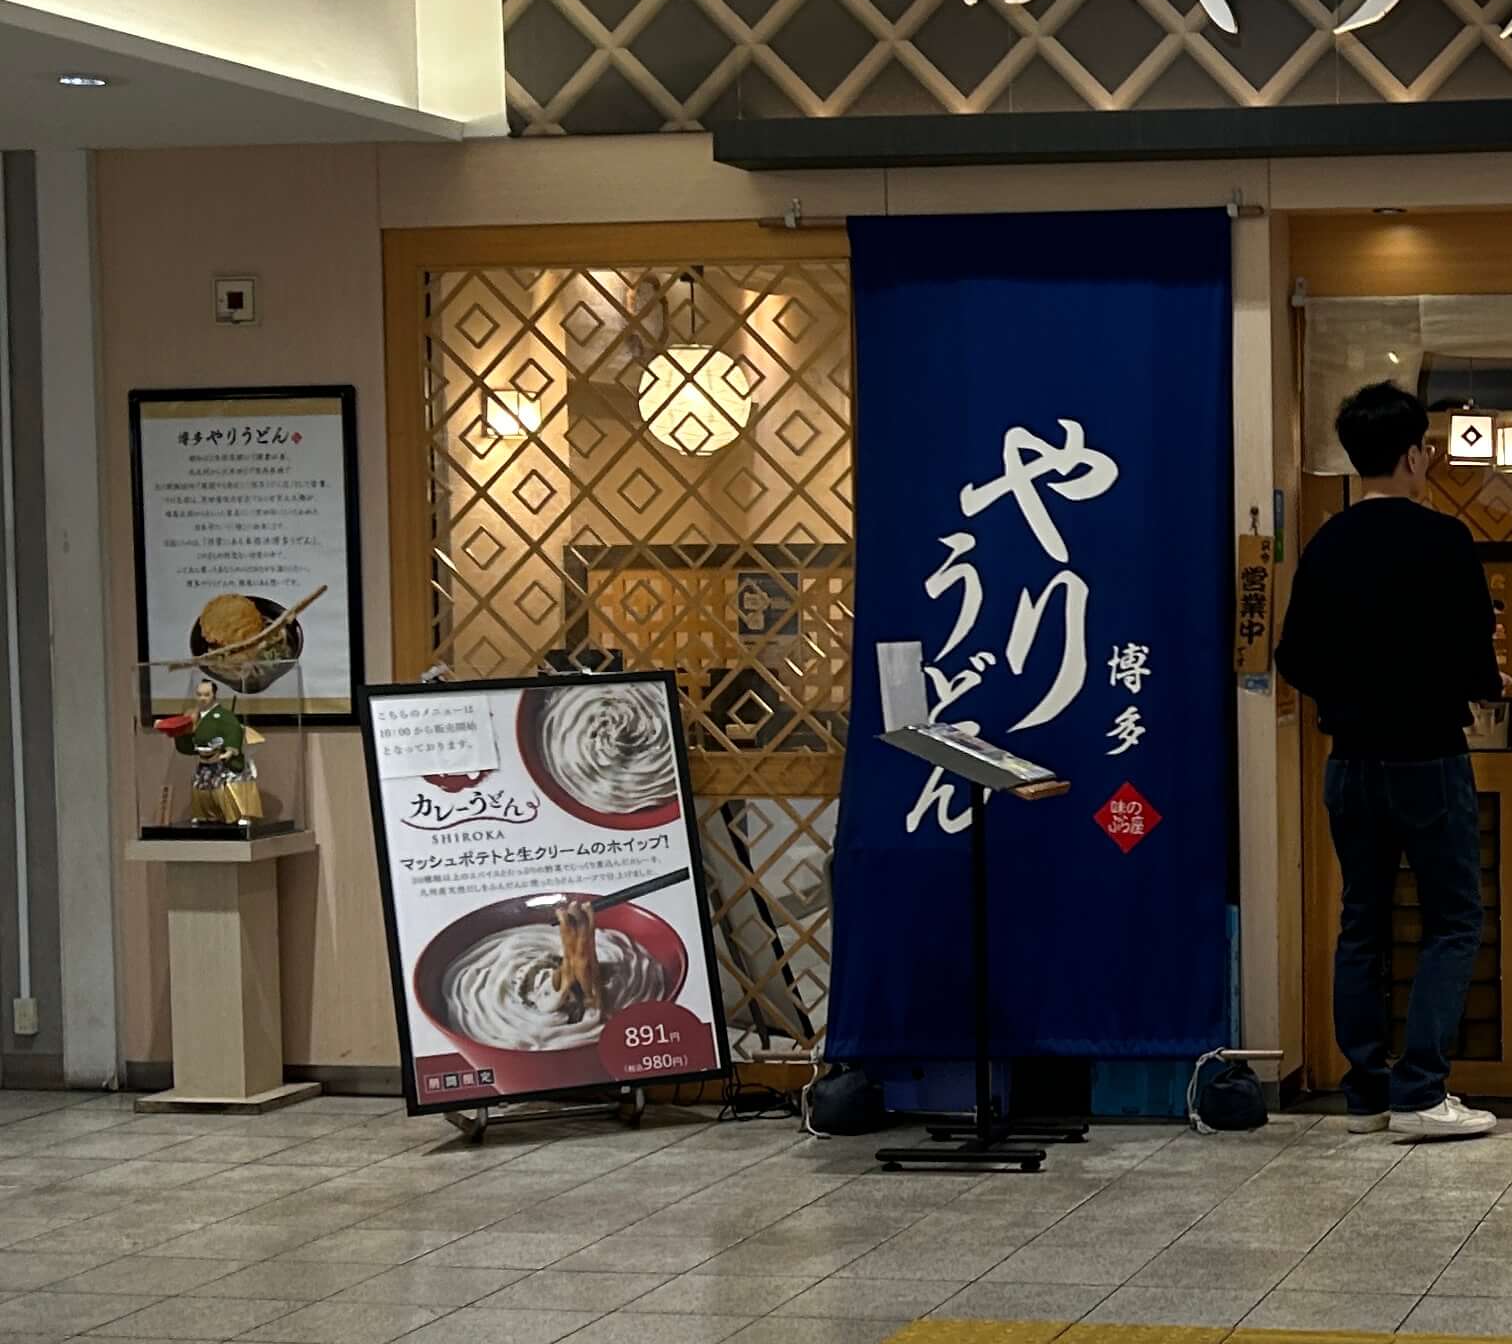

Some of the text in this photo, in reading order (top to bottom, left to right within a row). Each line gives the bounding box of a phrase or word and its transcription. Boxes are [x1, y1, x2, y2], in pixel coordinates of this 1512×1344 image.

[1240, 565, 1269, 645] 営業中
[1105, 643, 1151, 756] 博多
[410, 790, 525, 821] カレーうどん
[1110, 799, 1144, 816] 味の
[431, 829, 506, 845] SHIROKA
[623, 1022, 682, 1047] 891円
